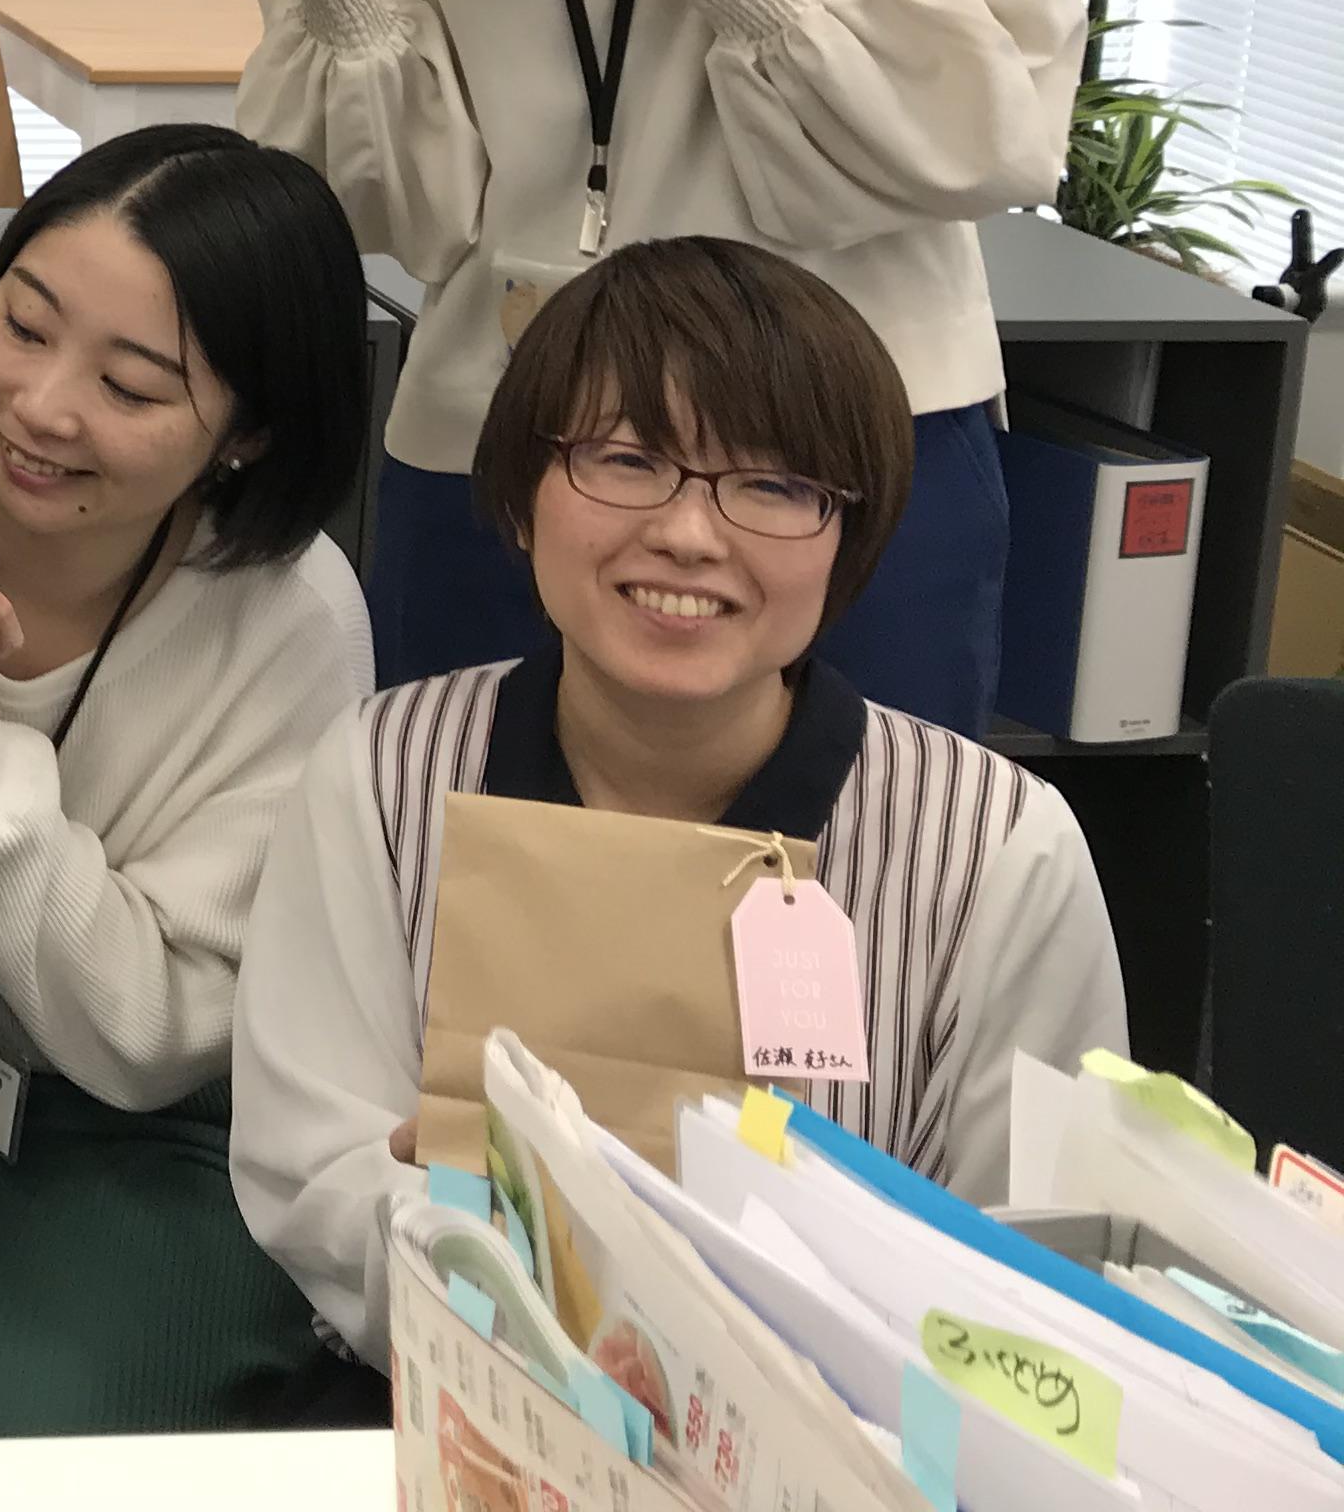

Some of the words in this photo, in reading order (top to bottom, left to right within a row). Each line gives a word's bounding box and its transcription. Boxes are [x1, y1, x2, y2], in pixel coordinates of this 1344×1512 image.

[772, 949, 823, 970] JUST
[779, 979, 823, 1001] FOR
[780, 1008, 827, 1031] YOU
